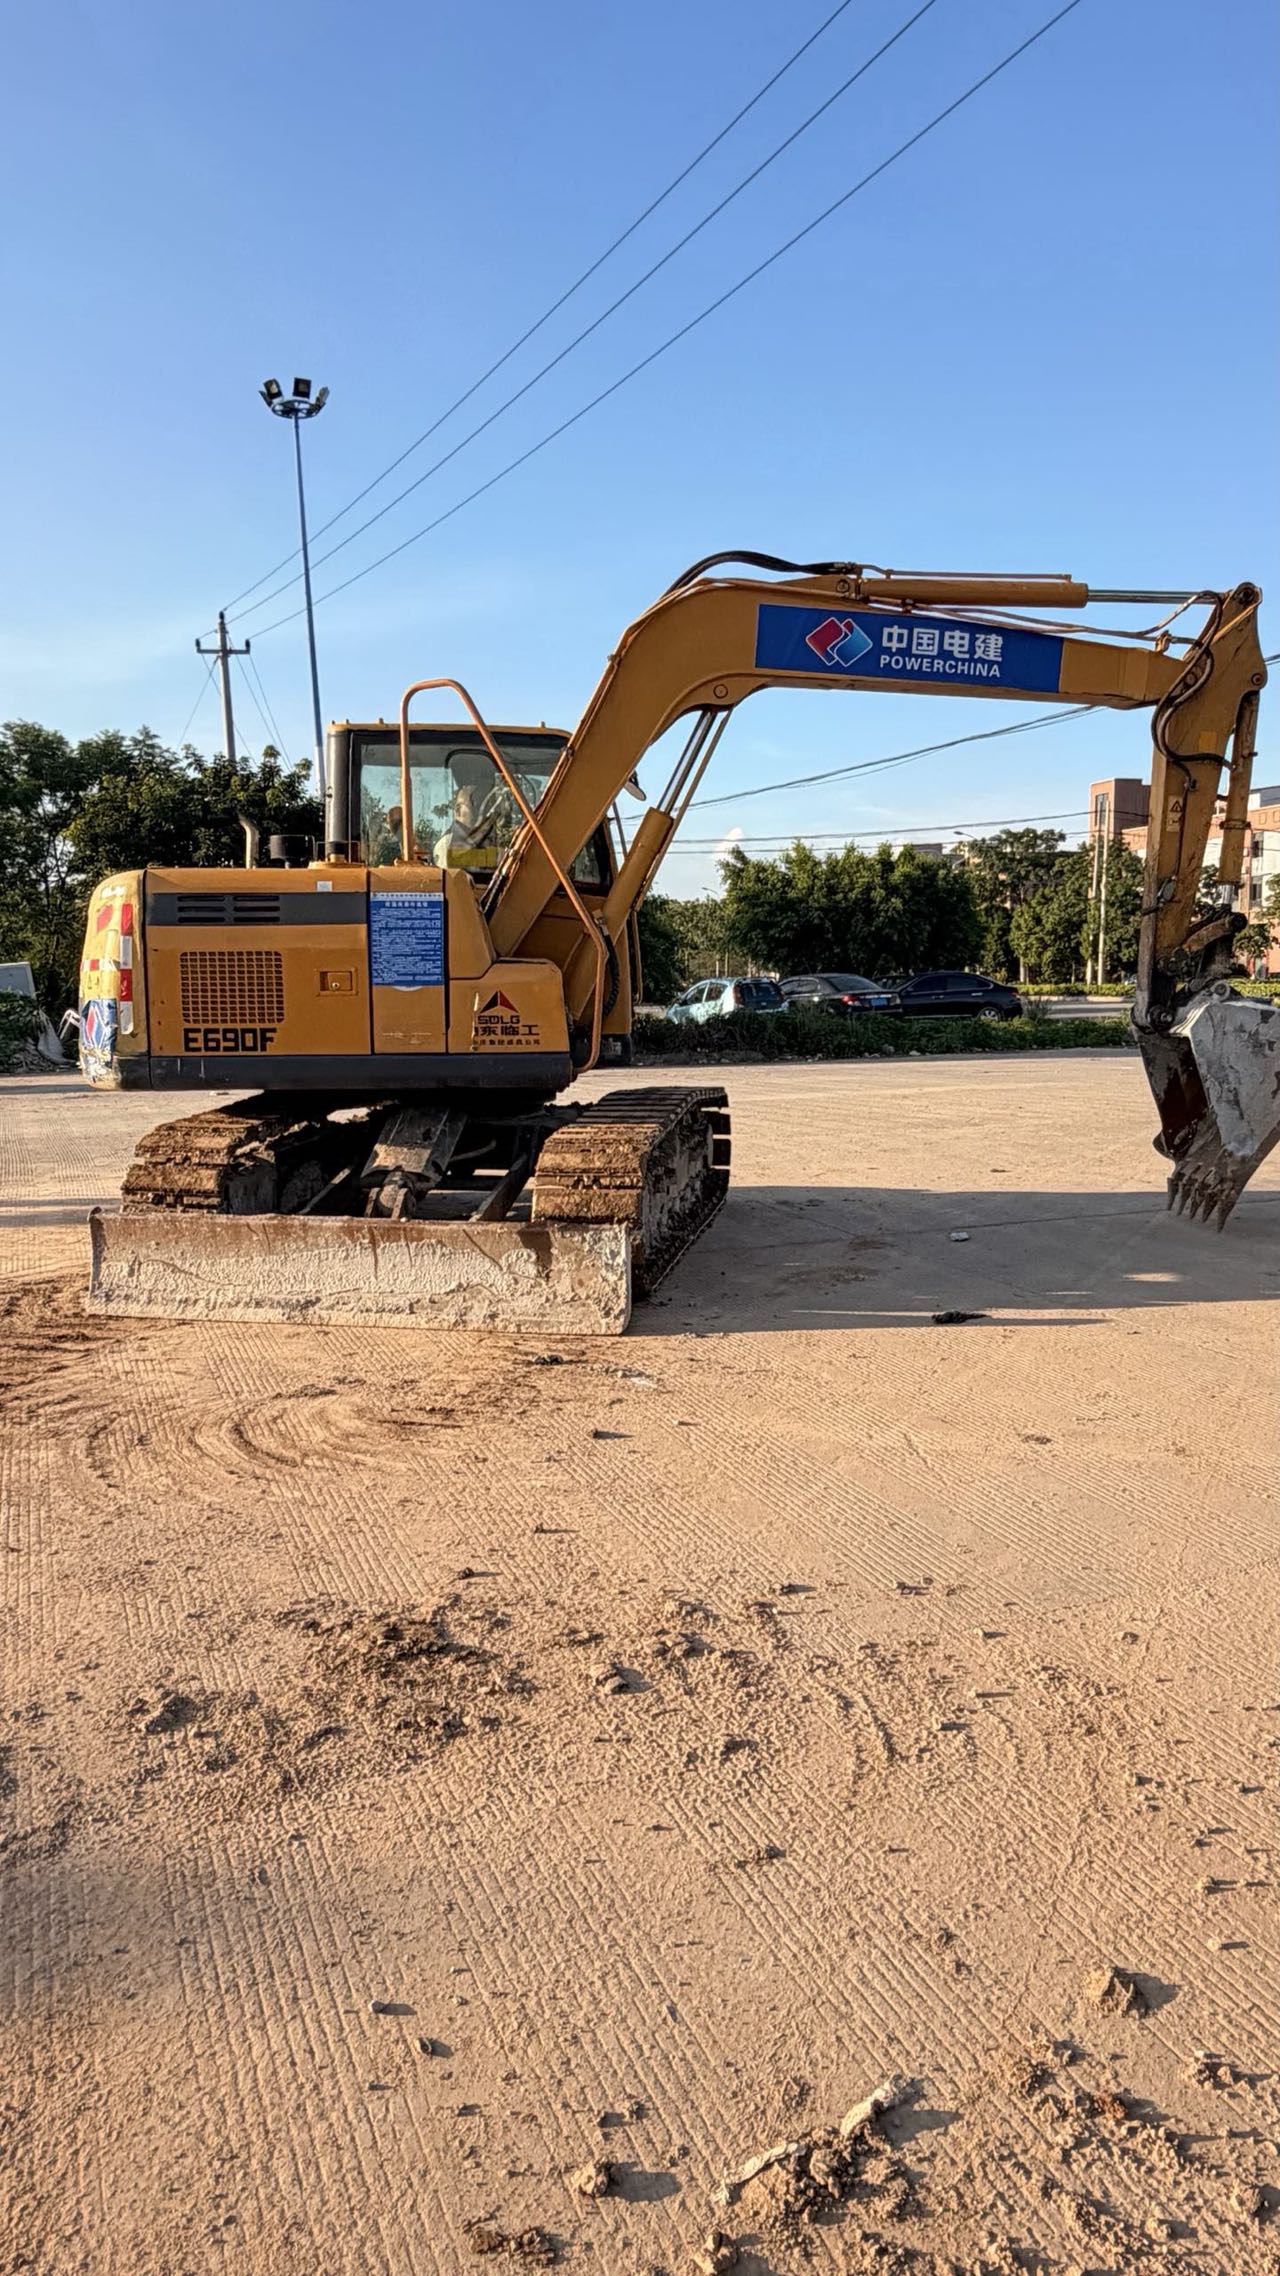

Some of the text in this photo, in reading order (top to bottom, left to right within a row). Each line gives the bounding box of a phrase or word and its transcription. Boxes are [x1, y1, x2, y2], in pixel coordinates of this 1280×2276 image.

[882, 625, 1003, 661] 中国电建
[880, 655, 1000, 677] POWERCHINA
[183, 1028, 277, 1052] E690F
[474, 1024, 540, 1036] 东临工
